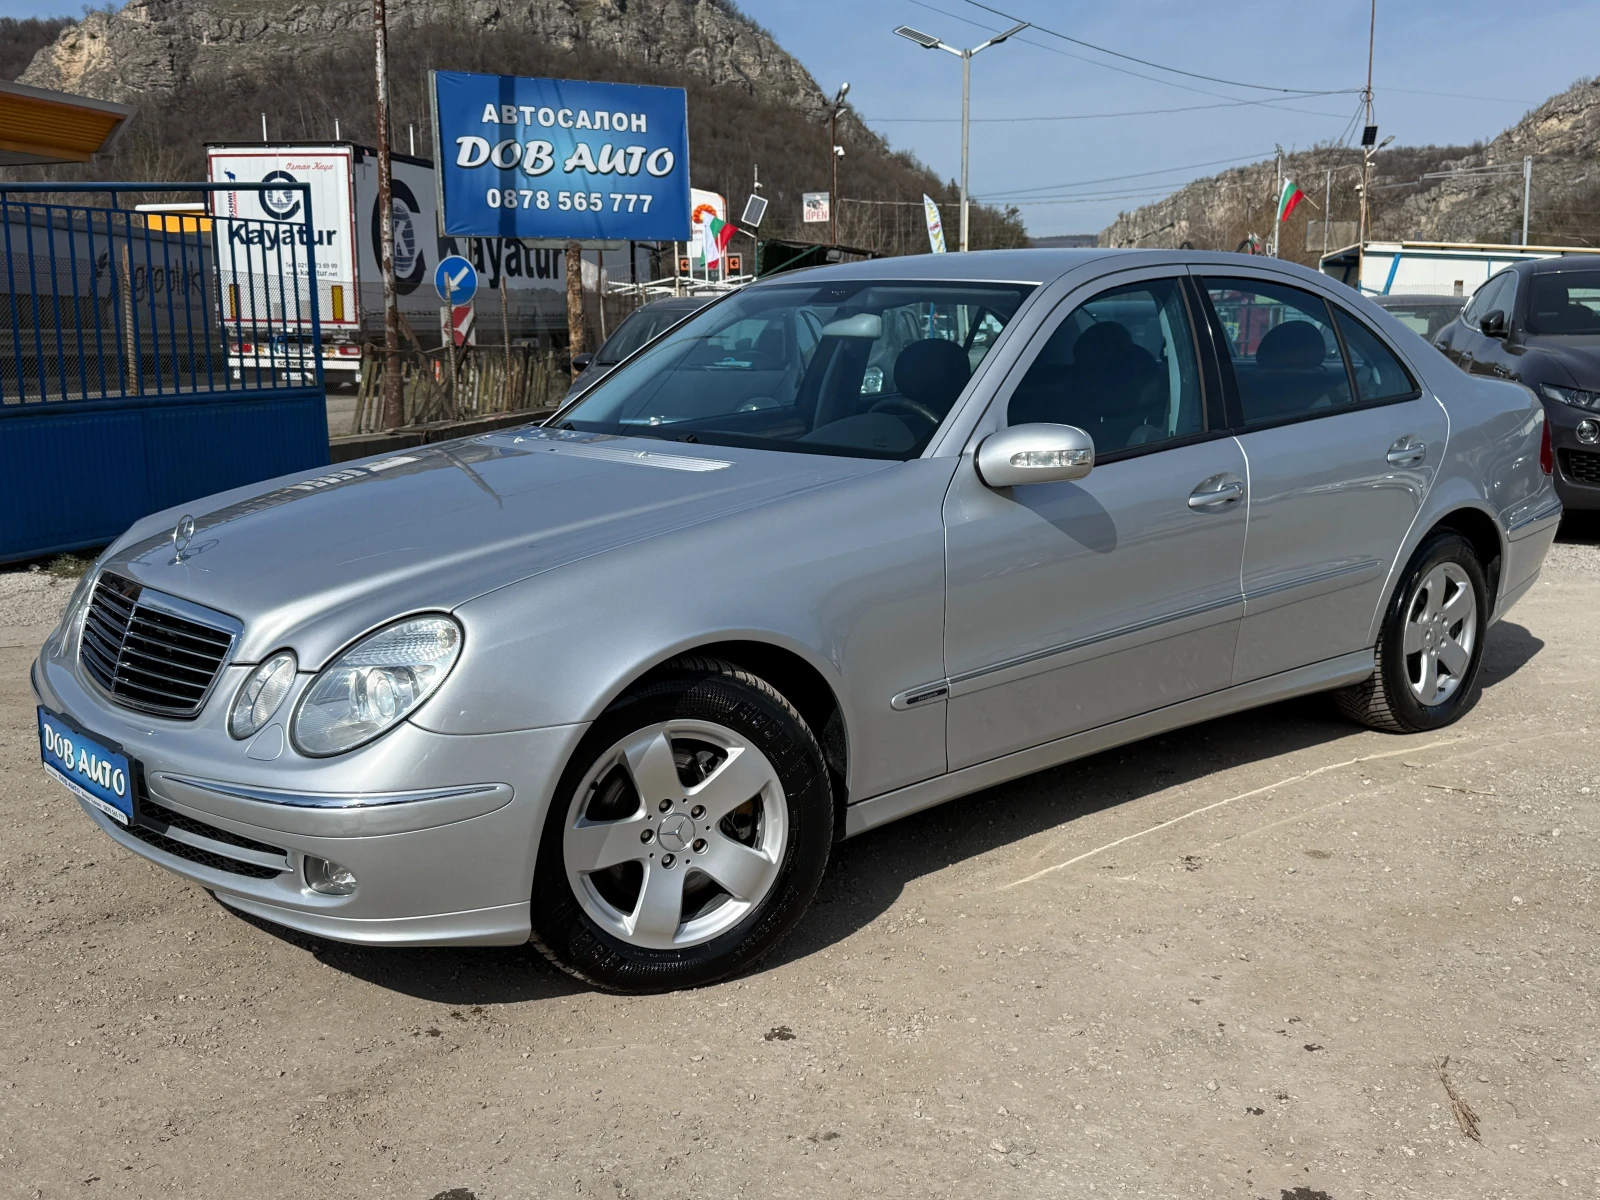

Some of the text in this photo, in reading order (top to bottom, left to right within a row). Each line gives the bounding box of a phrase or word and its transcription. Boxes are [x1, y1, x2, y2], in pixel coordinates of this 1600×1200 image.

[481, 103, 647, 133] АВТОСАЛОН
[285, 161, 333, 172] Osman Kaya
[455, 136, 675, 177] DOB AUTO
[486, 188, 653, 214] 0878 565 777
[805, 211, 827, 220] OPEN
[43, 723, 125, 796] DOB AUTO
